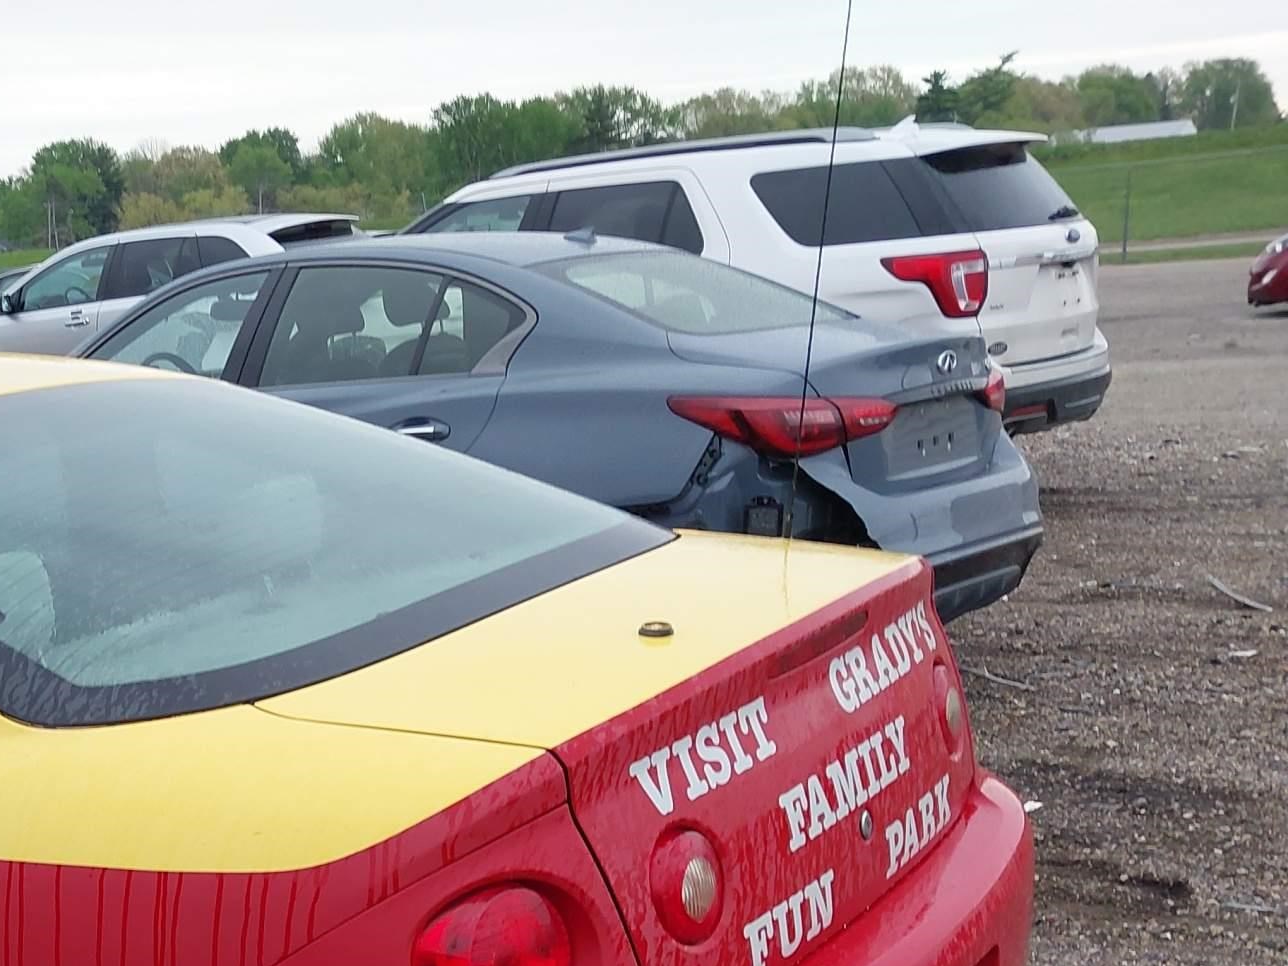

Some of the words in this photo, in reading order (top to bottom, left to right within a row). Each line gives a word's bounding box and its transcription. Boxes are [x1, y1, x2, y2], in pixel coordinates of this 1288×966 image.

[629, 696, 777, 816] VISIT
[828, 600, 937, 714] GRADY'S
[778, 715, 910, 853] FAMILY
[885, 773, 952, 880] PARK
